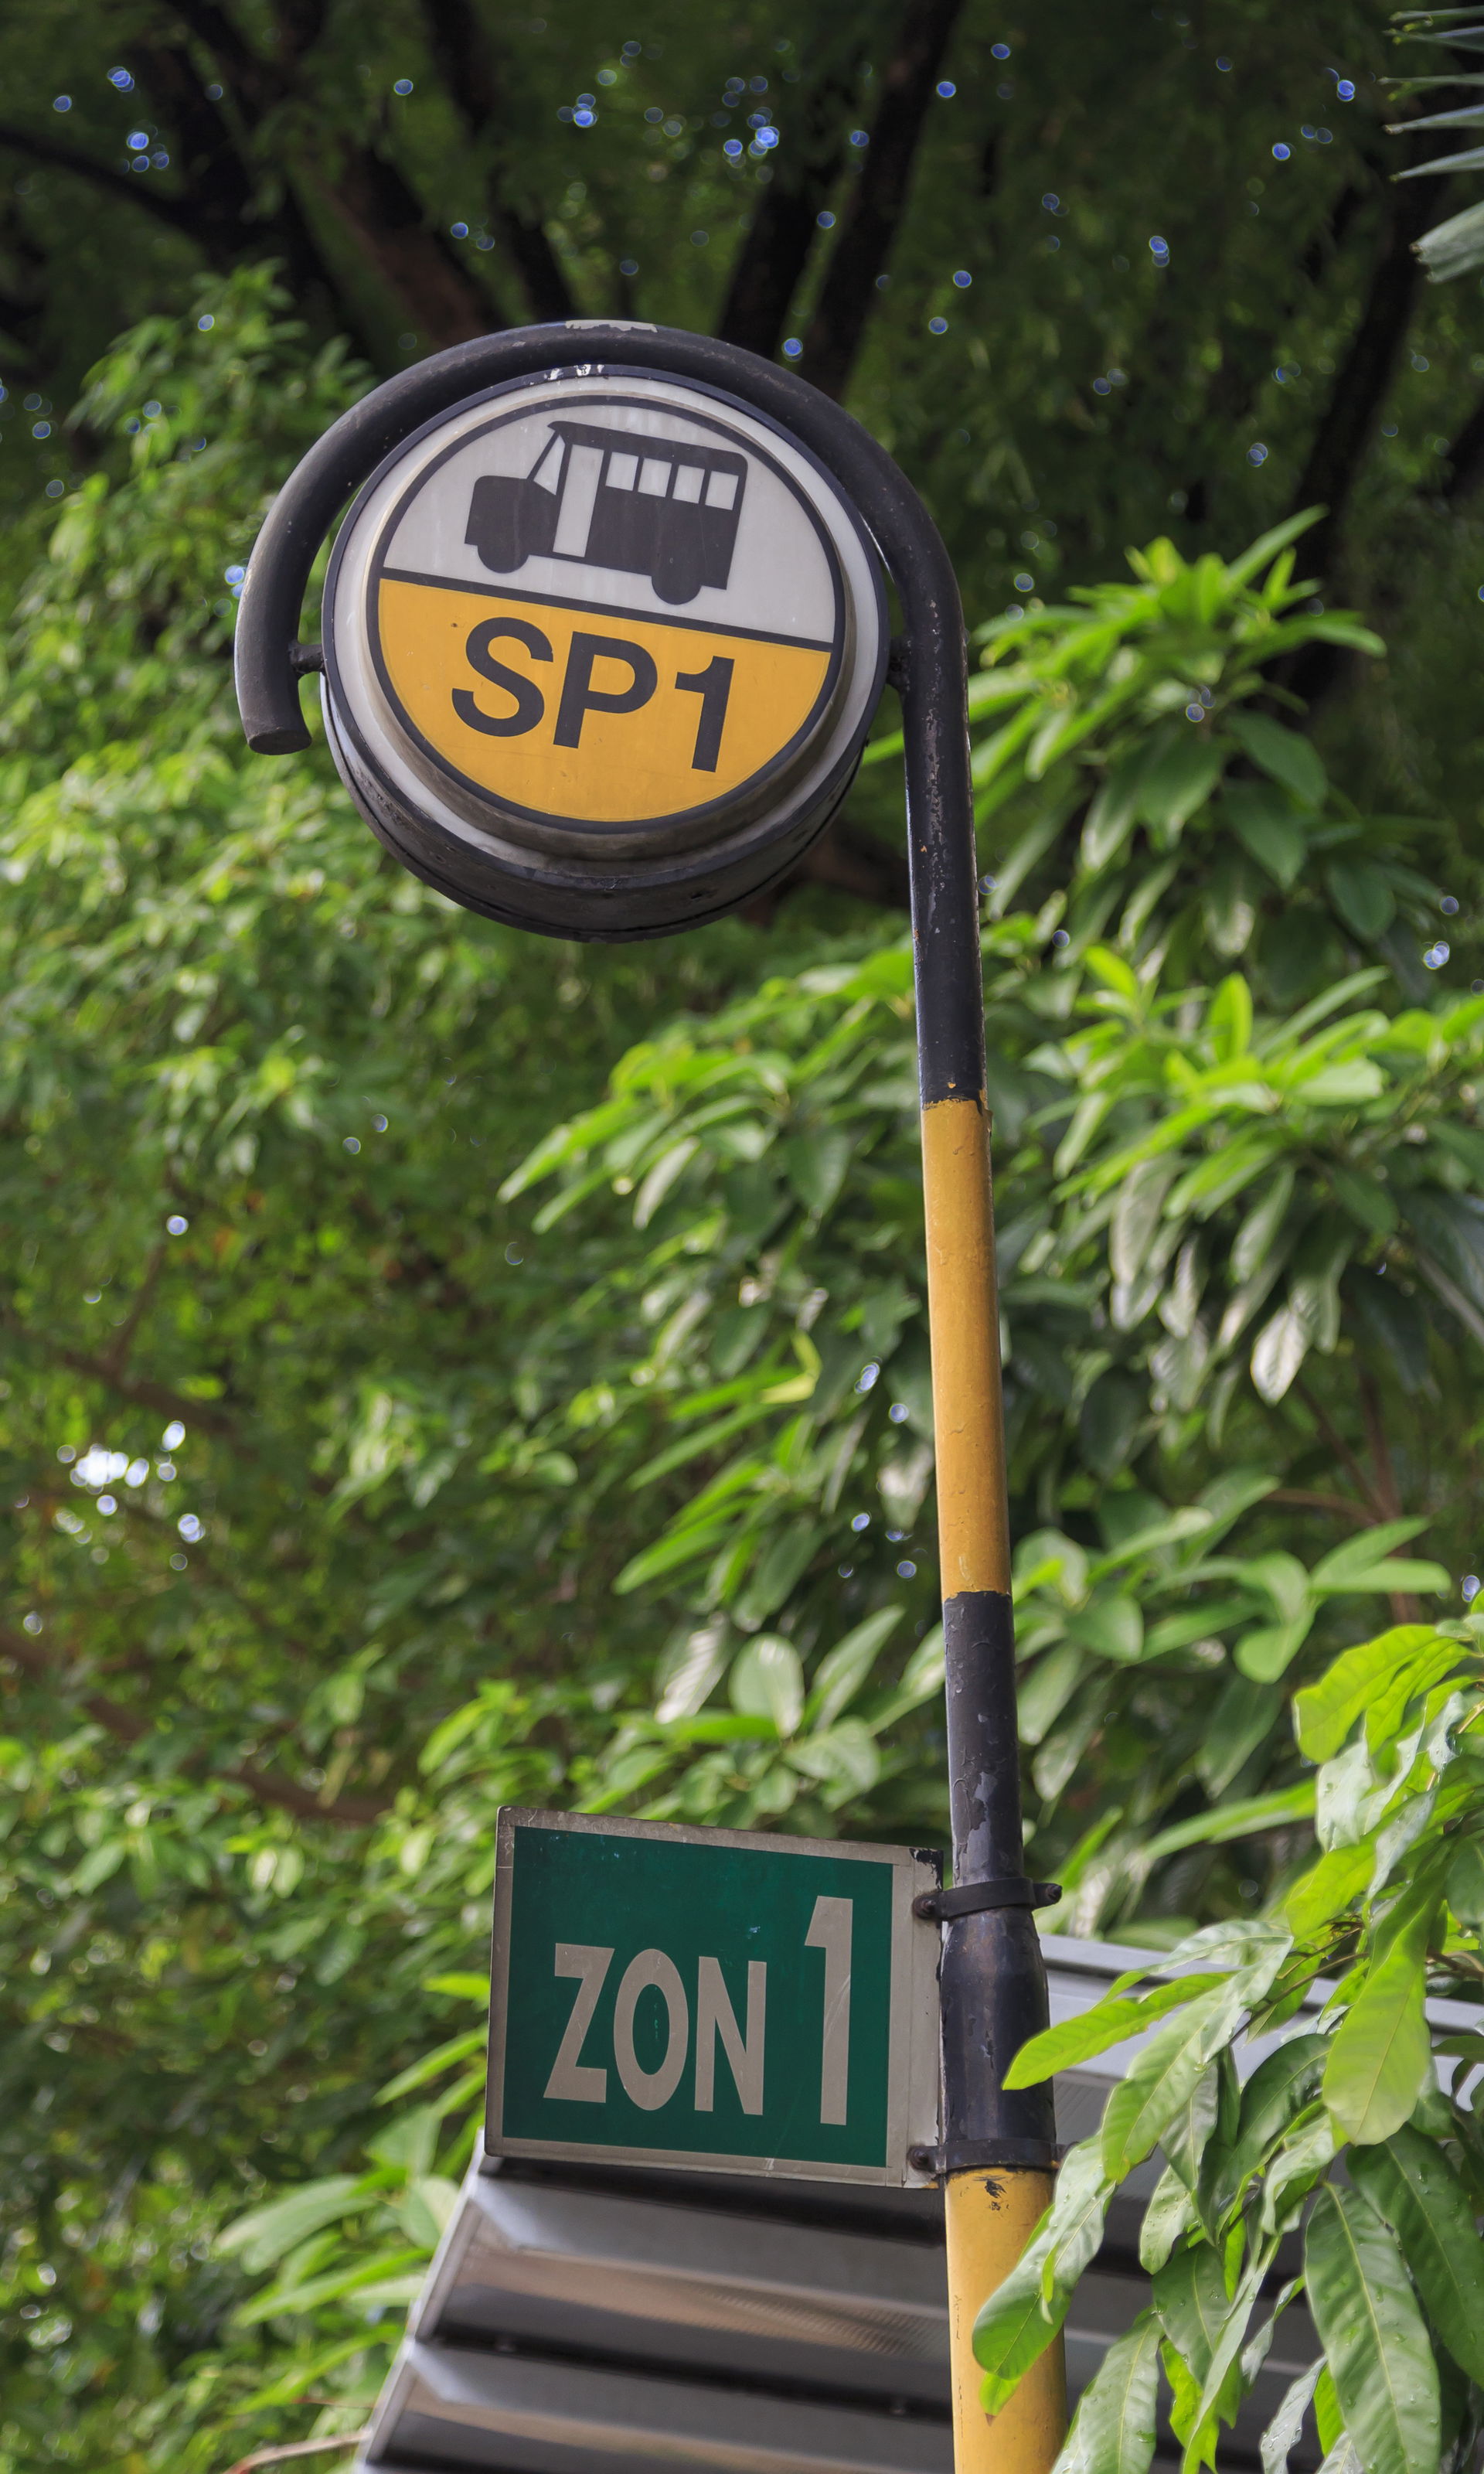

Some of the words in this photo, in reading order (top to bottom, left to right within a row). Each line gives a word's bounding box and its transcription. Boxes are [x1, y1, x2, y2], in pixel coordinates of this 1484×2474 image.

[451, 617, 735, 772] SP1
[543, 1943, 767, 2115] ZON
[804, 1896, 853, 2125] 1
